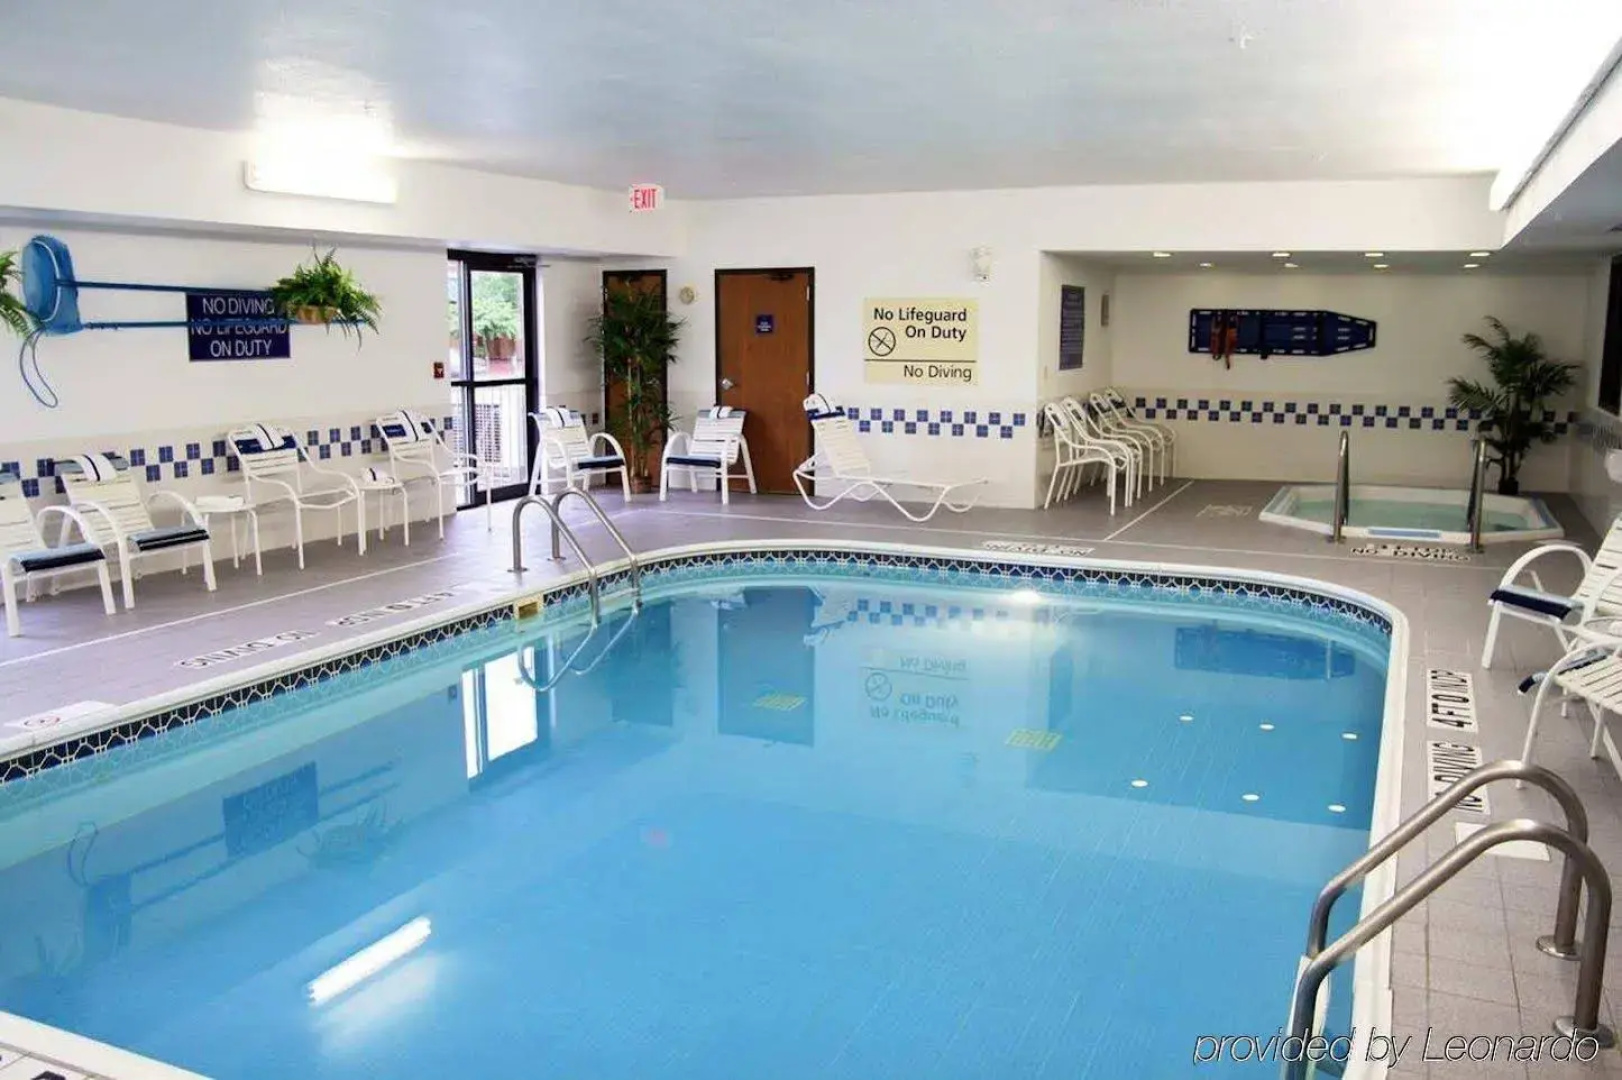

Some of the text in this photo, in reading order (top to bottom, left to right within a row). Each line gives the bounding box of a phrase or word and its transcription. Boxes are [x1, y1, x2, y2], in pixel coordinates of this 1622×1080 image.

[633, 188, 657, 209] EXIT
[202, 296, 275, 315] NO DIVING
[873, 306, 967, 325] No Lifeguard
[905, 325, 967, 342] On Duty
[210, 338, 273, 358] ON DUTY
[903, 364, 972, 382] No Diving
